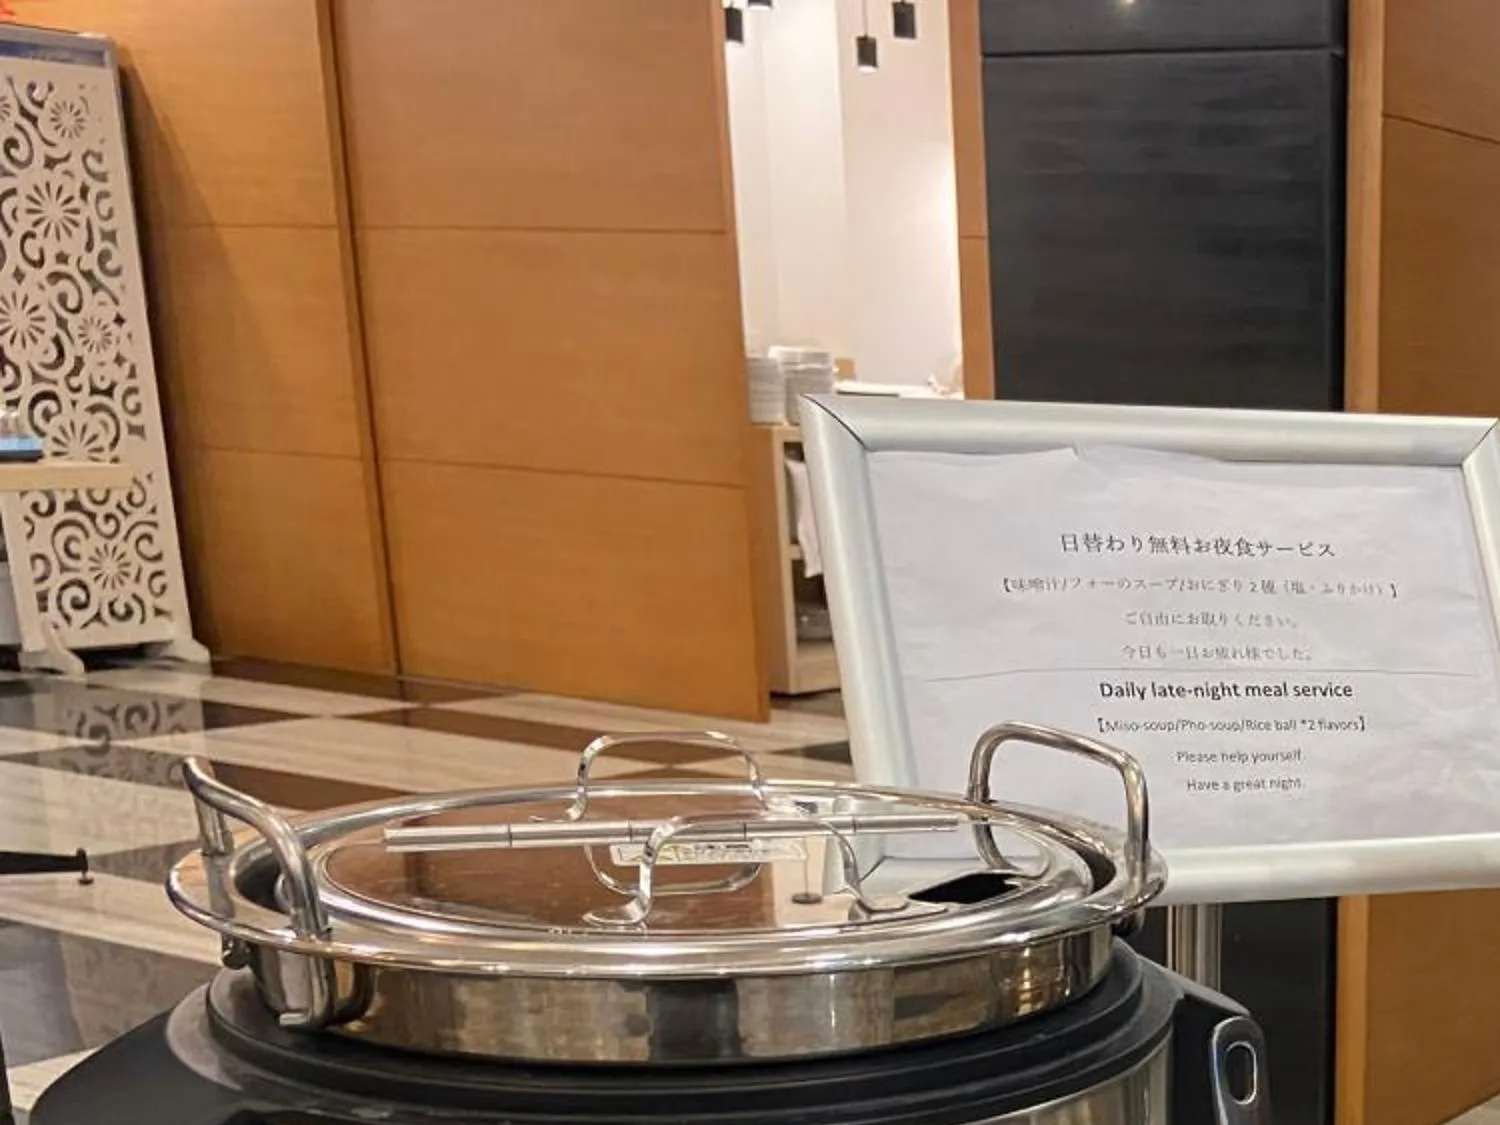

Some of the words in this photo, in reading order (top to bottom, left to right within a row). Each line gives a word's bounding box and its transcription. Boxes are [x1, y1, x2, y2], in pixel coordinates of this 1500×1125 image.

[1060, 530, 1336, 557] 日替わり無料お夜食サービス
[1100, 681, 1146, 700] Daily
[1150, 681, 1240, 700] late-night
[1245, 681, 1288, 698] meal
[1292, 681, 1353, 698] service
[1275, 718, 1297, 732] ball
[1176, 750, 1217, 762] Please
[1221, 751, 1248, 765] help
[1186, 779, 1220, 791] Have
[1223, 781, 1230, 791] a
[1233, 779, 1266, 793] great
